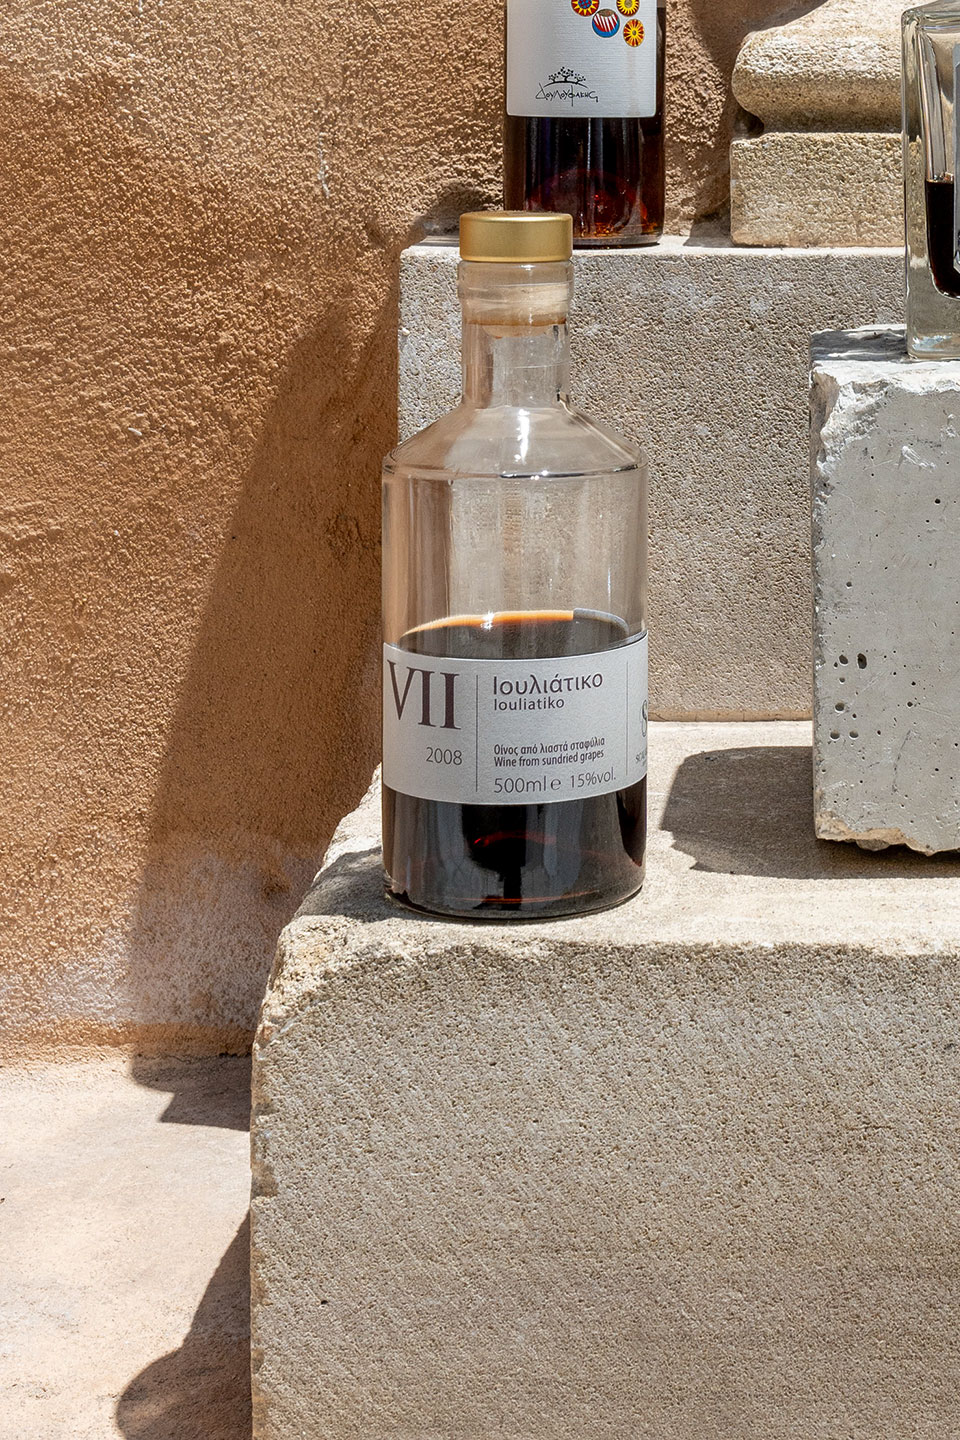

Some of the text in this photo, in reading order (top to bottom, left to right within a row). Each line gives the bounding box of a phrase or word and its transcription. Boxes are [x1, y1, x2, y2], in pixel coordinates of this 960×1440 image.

[387, 659, 462, 730] VII
[493, 673, 603, 696] Ιουλιάτικο
[494, 696, 565, 712] Iouliatiko
[426, 746, 463, 766] 2008
[494, 736, 605, 756] Οίνος από λιαστά σταφύλια
[494, 748, 604, 767] Wine from sundried grapes
[570, 766, 617, 789] 15%vol.
